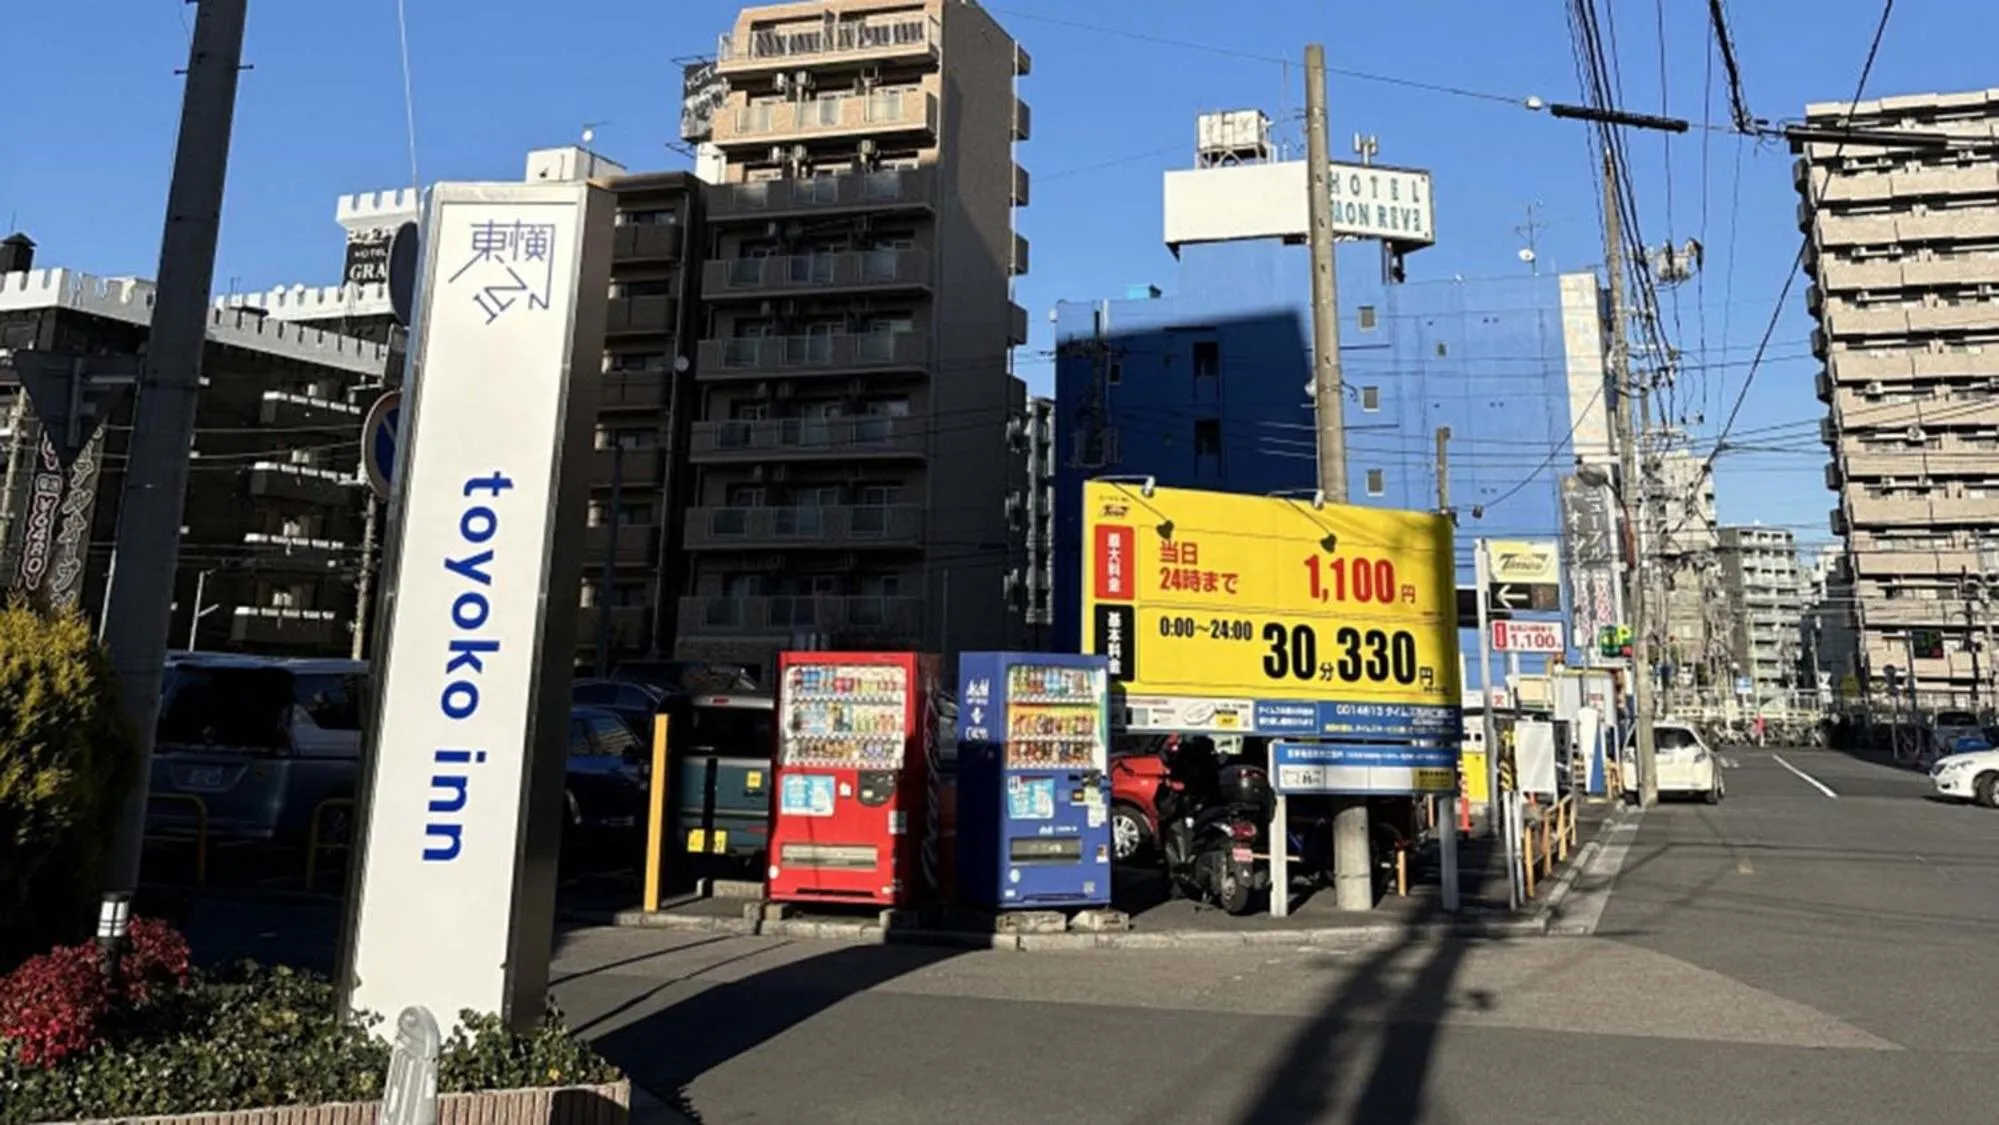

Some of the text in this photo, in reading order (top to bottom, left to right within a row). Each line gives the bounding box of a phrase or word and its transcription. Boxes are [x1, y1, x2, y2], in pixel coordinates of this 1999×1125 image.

[1328, 171, 1421, 203] HOTEL
[1159, 541, 1198, 565] 当日
[1159, 567, 1239, 595] 24時まで
[422, 471, 514, 861] toyoko inn
